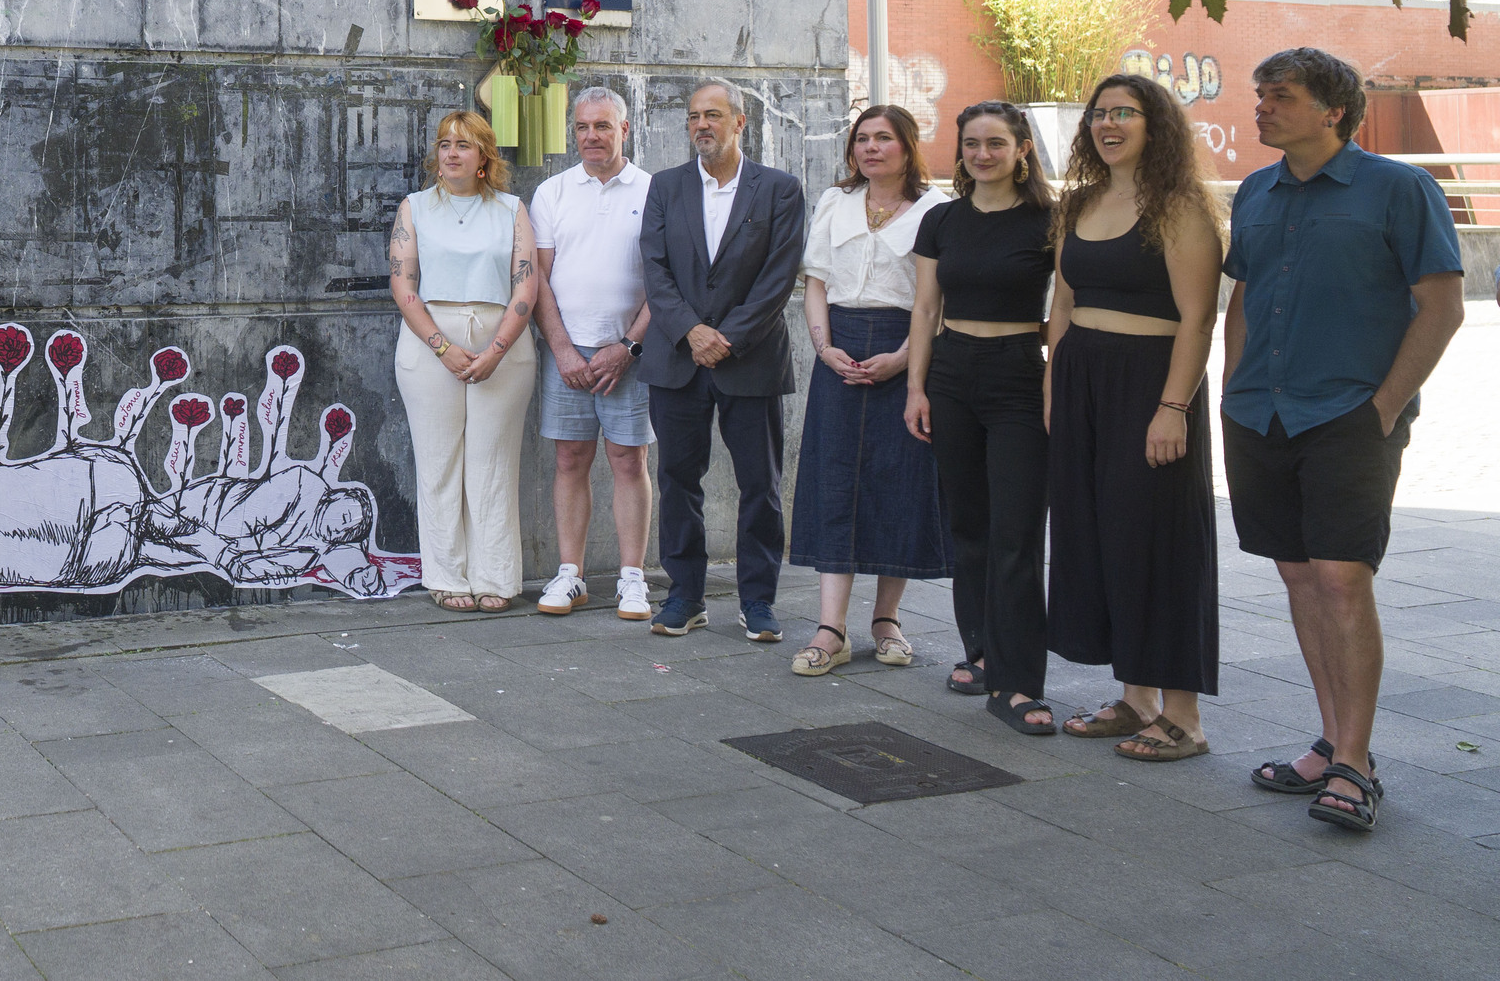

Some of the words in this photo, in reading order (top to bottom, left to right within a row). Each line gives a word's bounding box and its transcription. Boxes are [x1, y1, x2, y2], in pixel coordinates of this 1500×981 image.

[73, 380, 87, 419] manuel
[118, 390, 142, 428] antonio
[261, 388, 276, 425] julian
[235, 421, 247, 467] manuel
